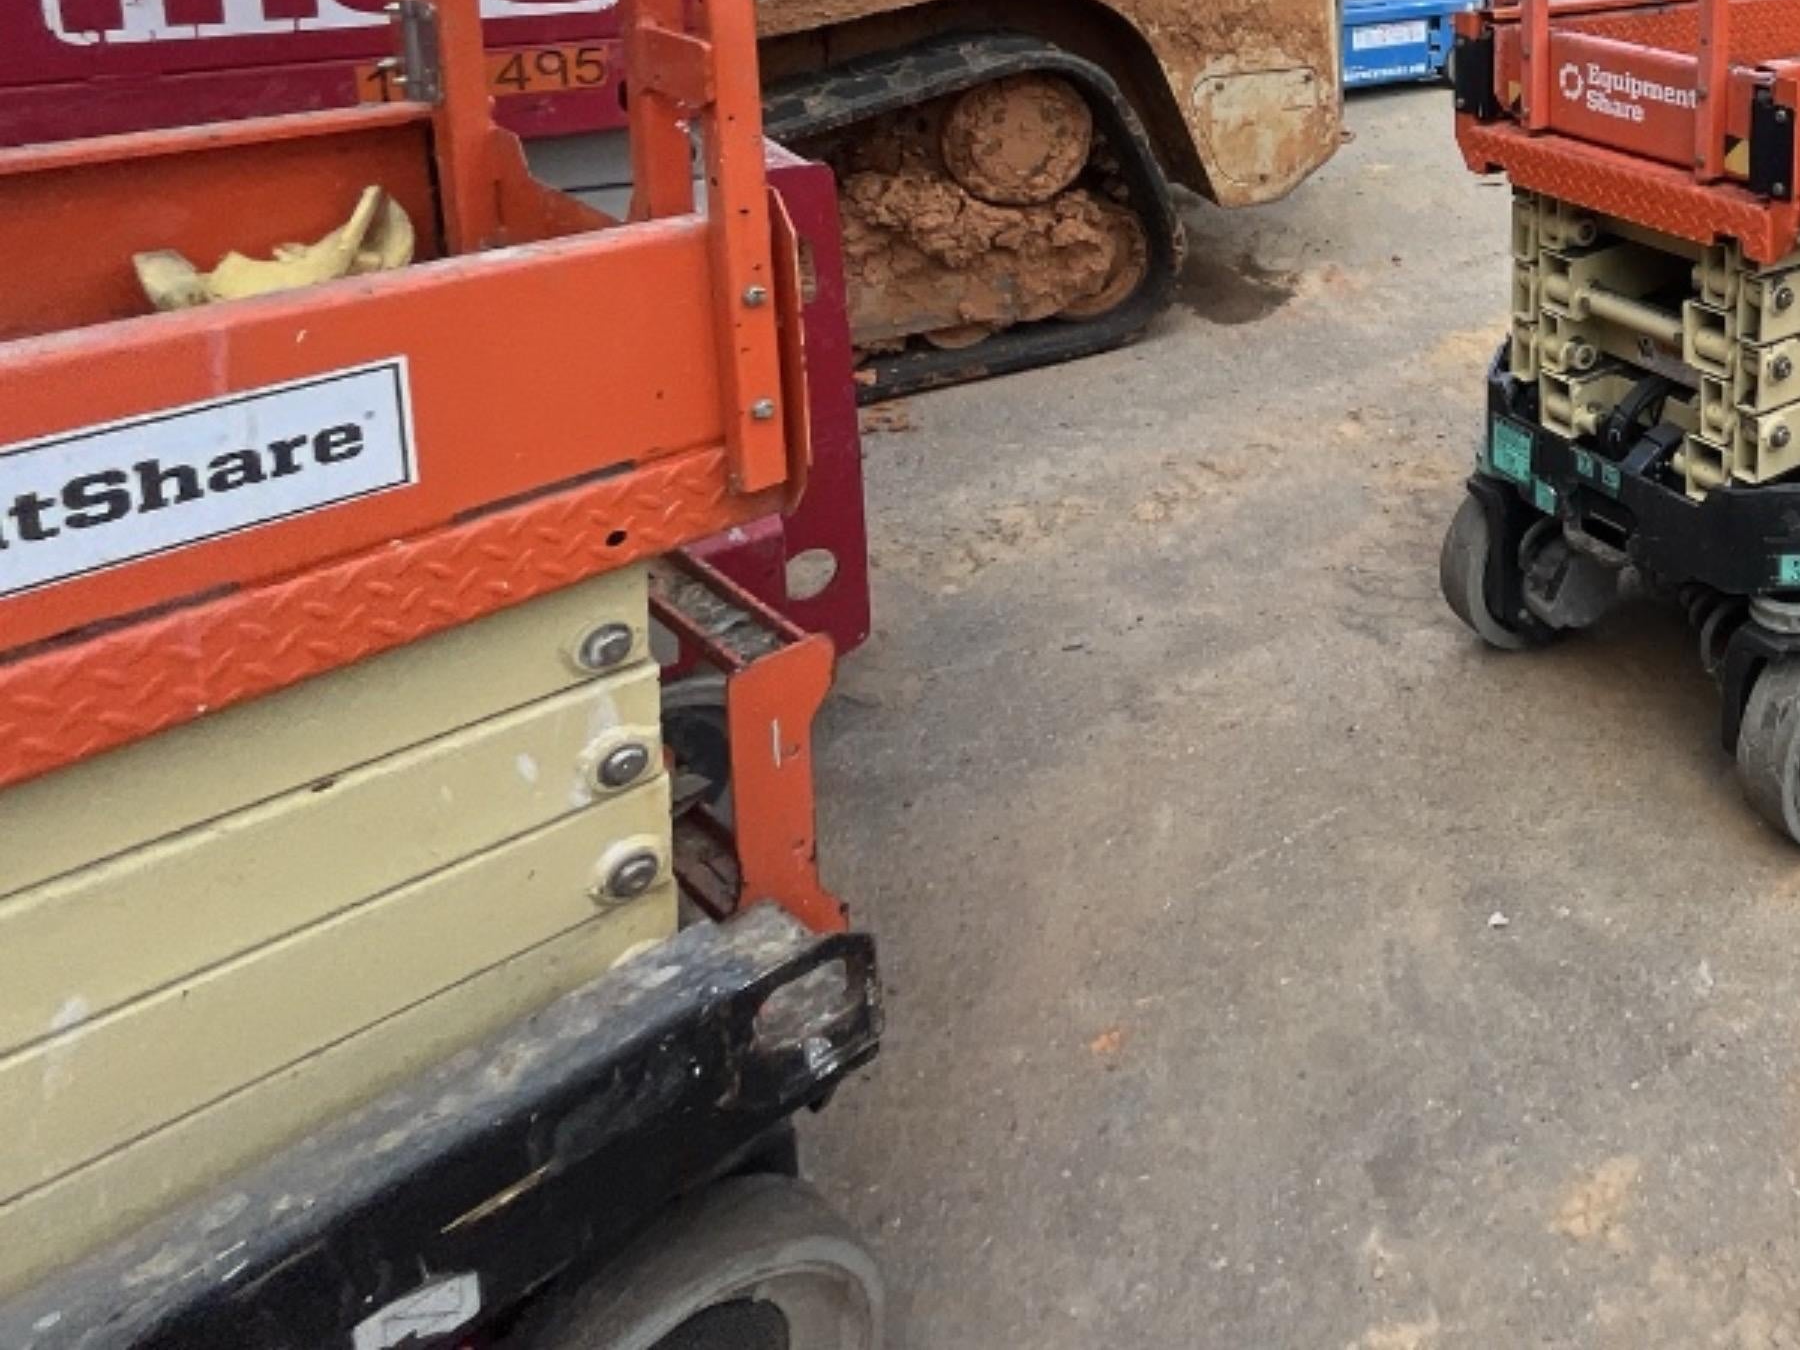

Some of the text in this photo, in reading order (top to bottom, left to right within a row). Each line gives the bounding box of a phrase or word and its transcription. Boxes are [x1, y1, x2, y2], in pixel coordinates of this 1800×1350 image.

[1585, 86, 1646, 123] Share
[1586, 61, 1698, 109] Equipment
[0, 422, 365, 550] tShare
